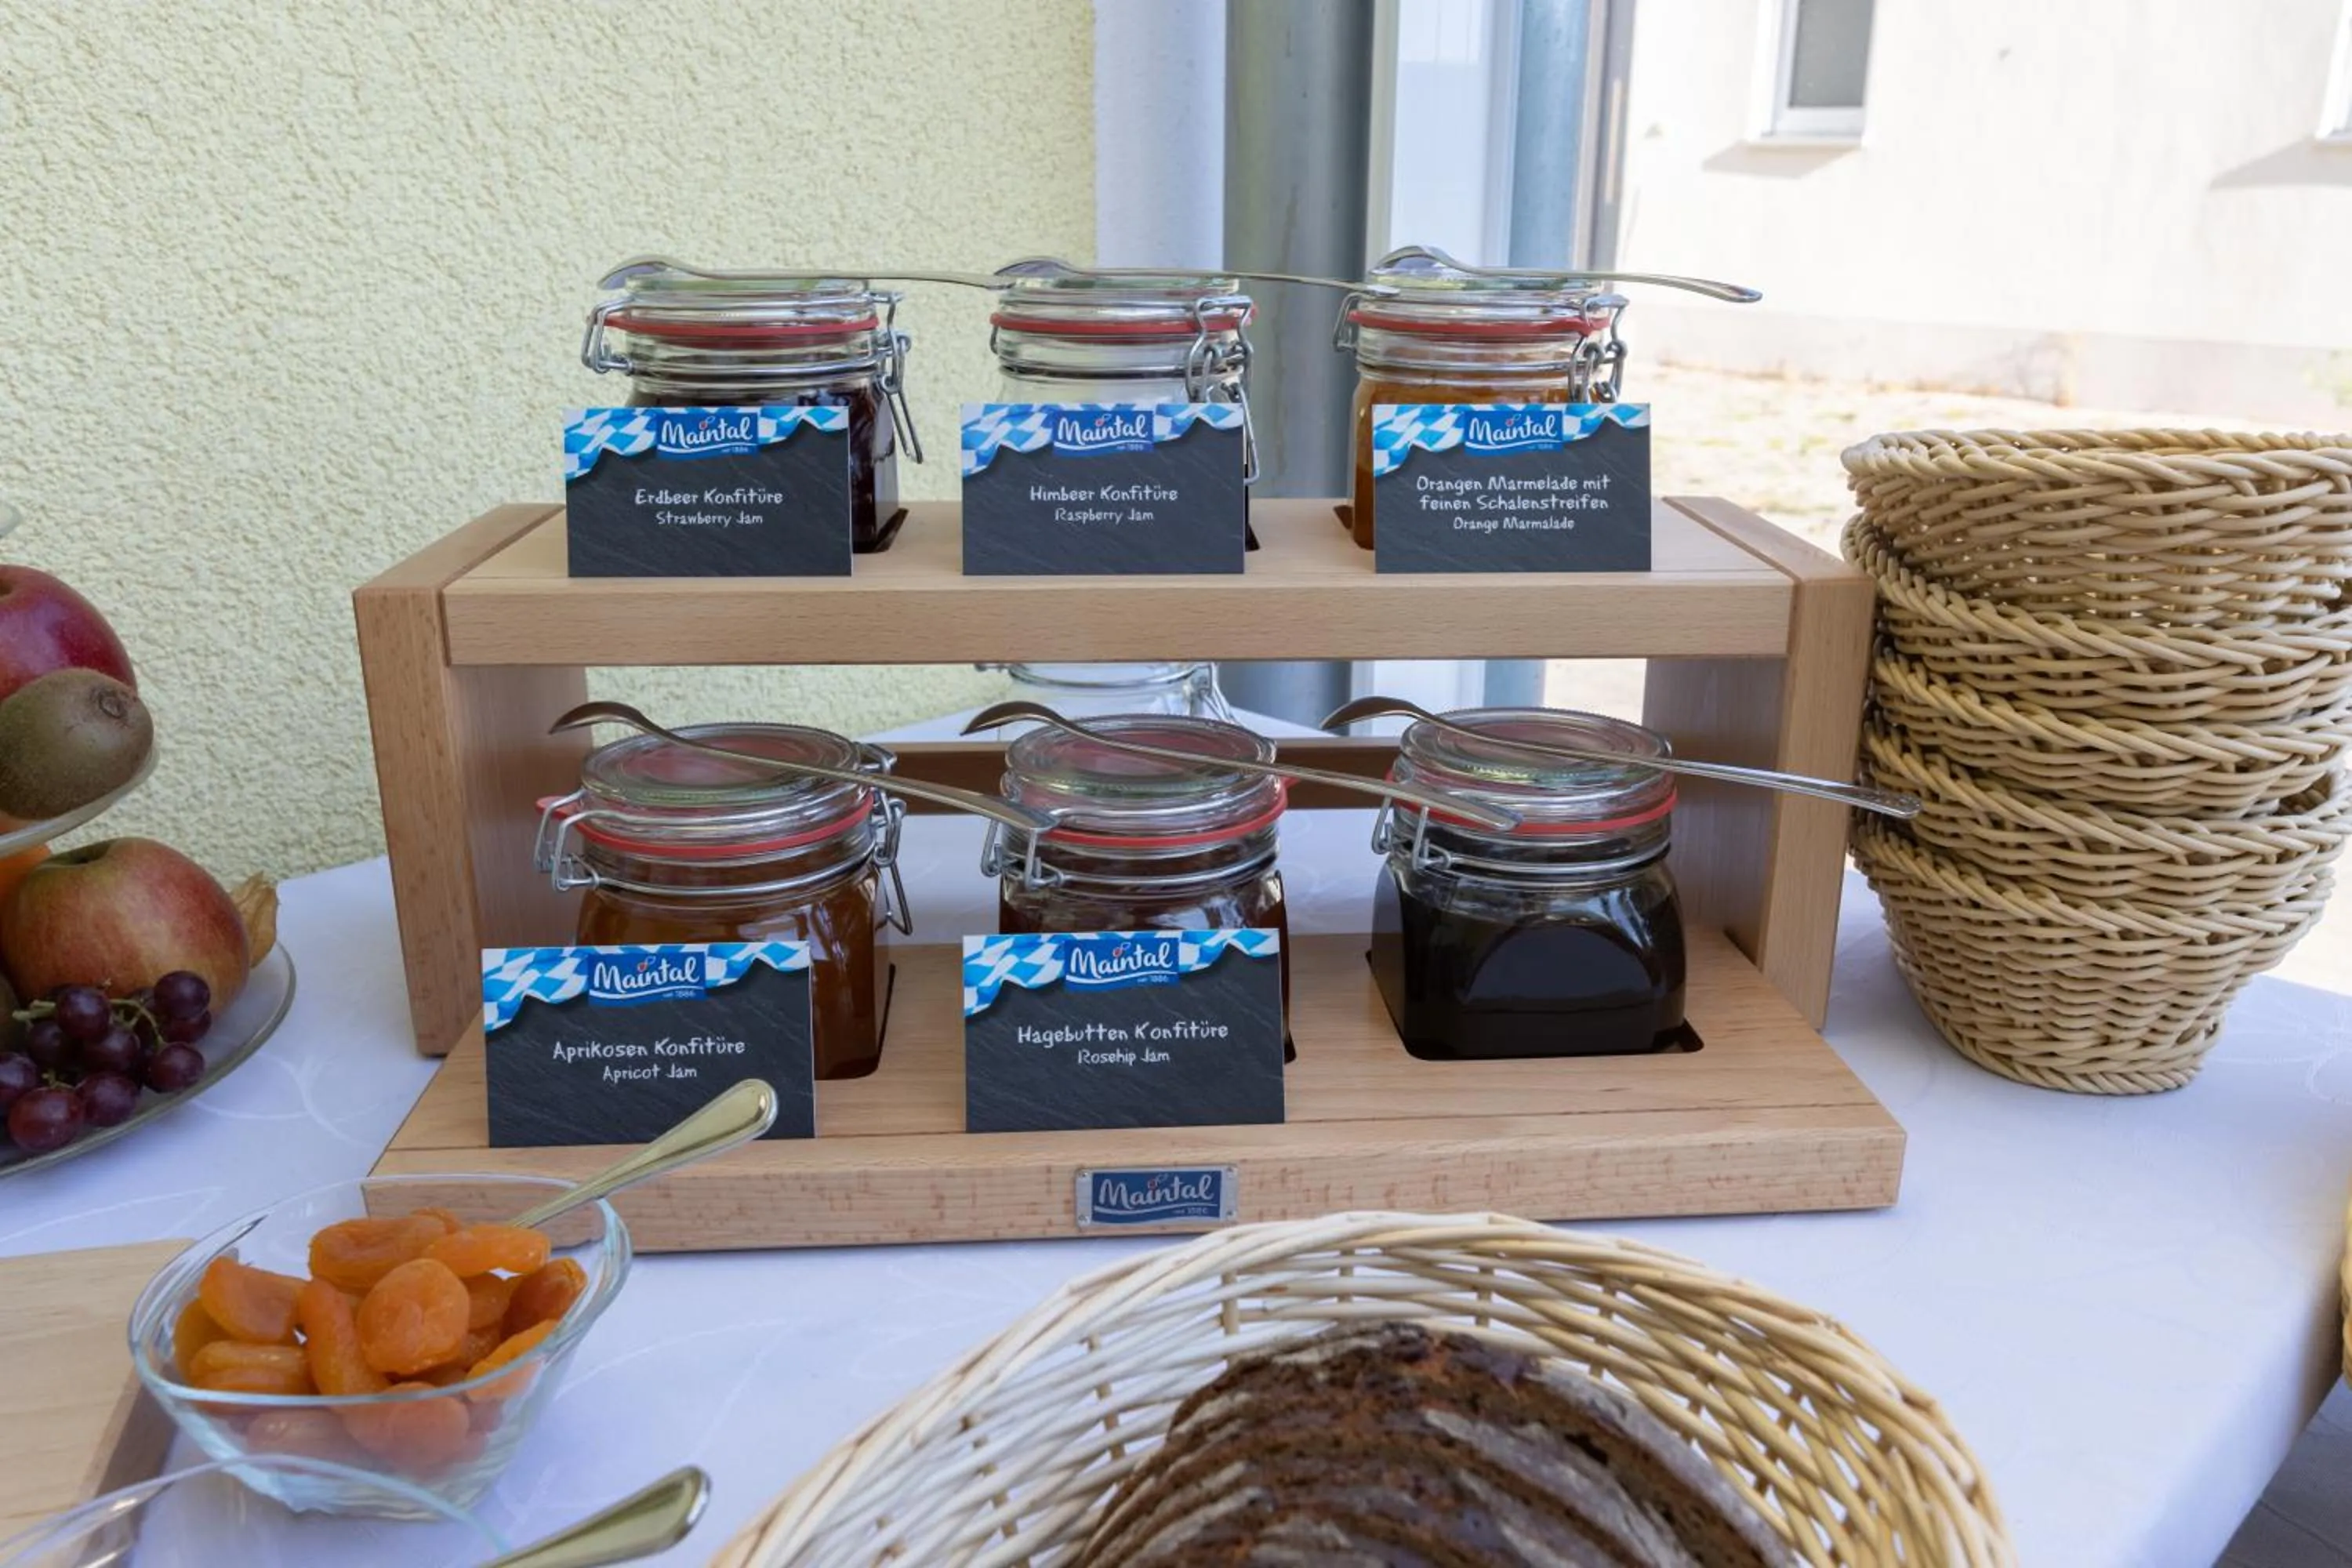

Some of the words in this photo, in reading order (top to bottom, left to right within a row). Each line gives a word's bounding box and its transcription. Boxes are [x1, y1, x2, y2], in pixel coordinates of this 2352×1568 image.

[662, 416, 753, 449] Maintal
[1058, 414, 1148, 445] Maintal
[1468, 414, 1557, 446] Maintal
[1029, 485, 1095, 501] Himbeer
[1099, 484, 1178, 502] Konfitüre
[1417, 475, 1483, 495] Orangen
[1488, 475, 1577, 491] Marmelade
[1583, 474, 1611, 490] mit
[635, 488, 699, 505] Erdbeer
[704, 487, 783, 505] Konfitüre
[1419, 495, 1471, 510] feinen
[1476, 494, 1609, 510] Schalenstreifen
[655, 510, 732, 528] Strawberry
[736, 510, 763, 524] Jam
[1054, 508, 1123, 524] Raspberry
[1127, 508, 1154, 521] Jam
[1454, 517, 1499, 534] Orange
[1503, 516, 1575, 530] Marmalade
[1070, 942, 1172, 978] Maintal
[593, 956, 699, 993] Maintal
[1018, 1024, 1129, 1048] Hagebutten
[1135, 1021, 1229, 1040] Konfitüre
[553, 1040, 648, 1063] Aprikosen
[654, 1036, 746, 1057] Konfitüre
[1078, 1047, 1136, 1066] Rosehip
[1142, 1047, 1170, 1063] Jam
[603, 1063, 660, 1083] Apricot
[666, 1063, 697, 1079] Jam
[1098, 1174, 1214, 1210] Maintal
